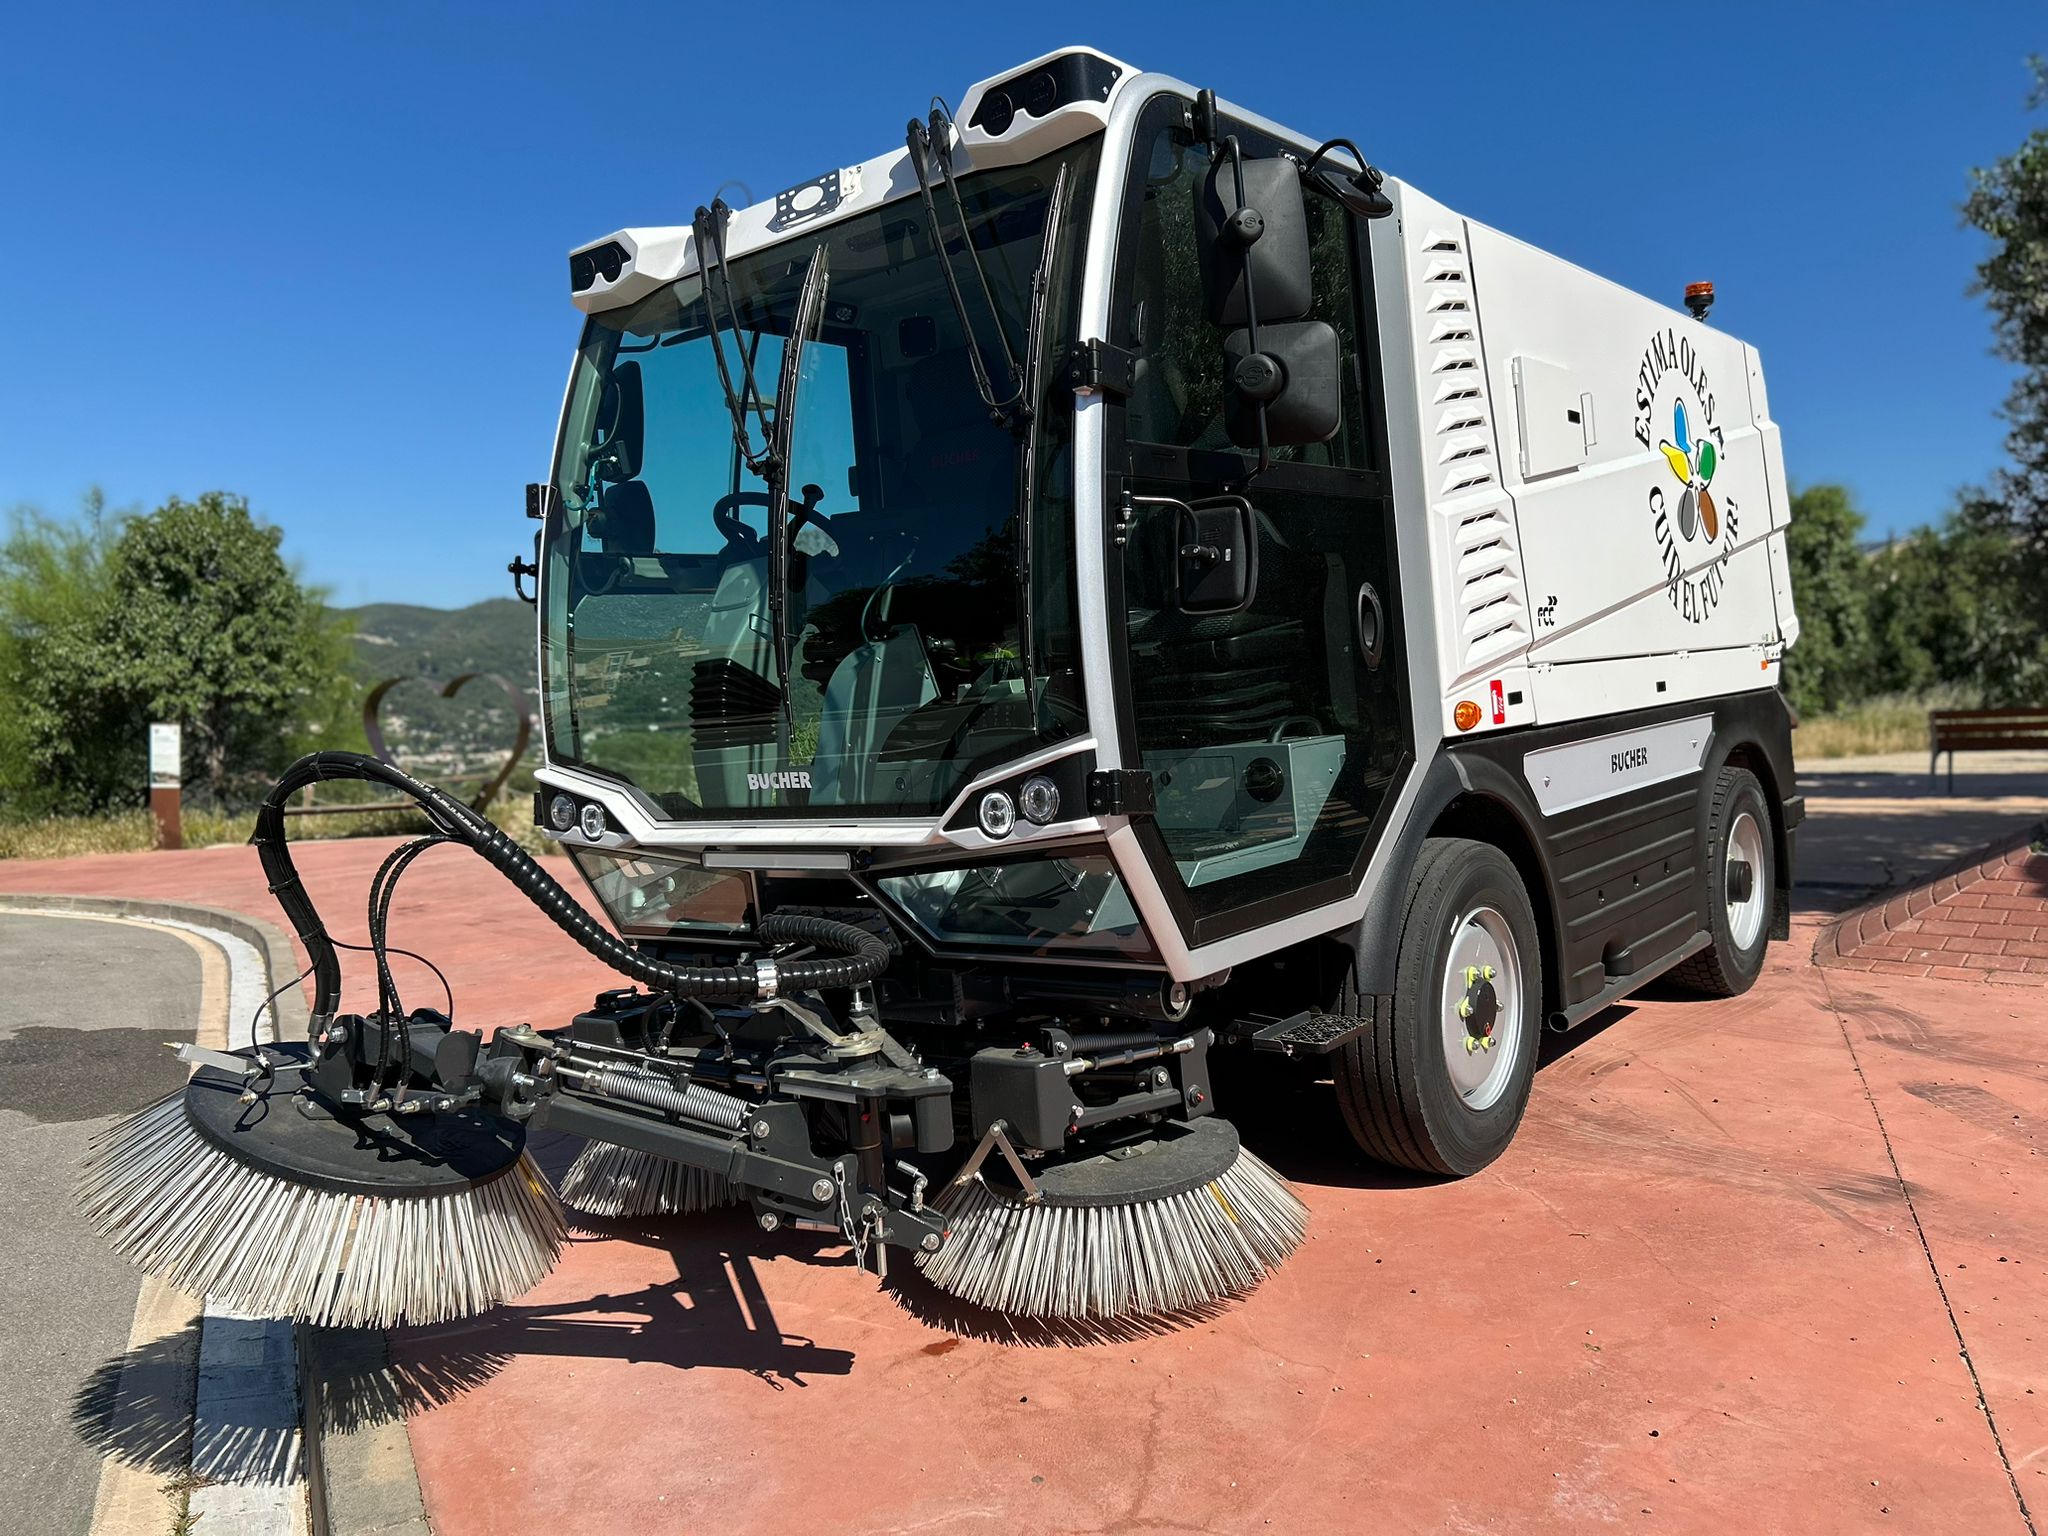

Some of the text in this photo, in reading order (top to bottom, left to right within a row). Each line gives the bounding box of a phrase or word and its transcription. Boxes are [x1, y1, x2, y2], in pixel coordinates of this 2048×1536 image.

[1635, 328, 1678, 452] ESTIMA
[1649, 486, 1738, 624] CUIDA EL FUTUR!
[1537, 606, 1555, 627] FCC
[1611, 746, 1648, 774] BUCHER
[747, 771, 812, 790] BUCHER
